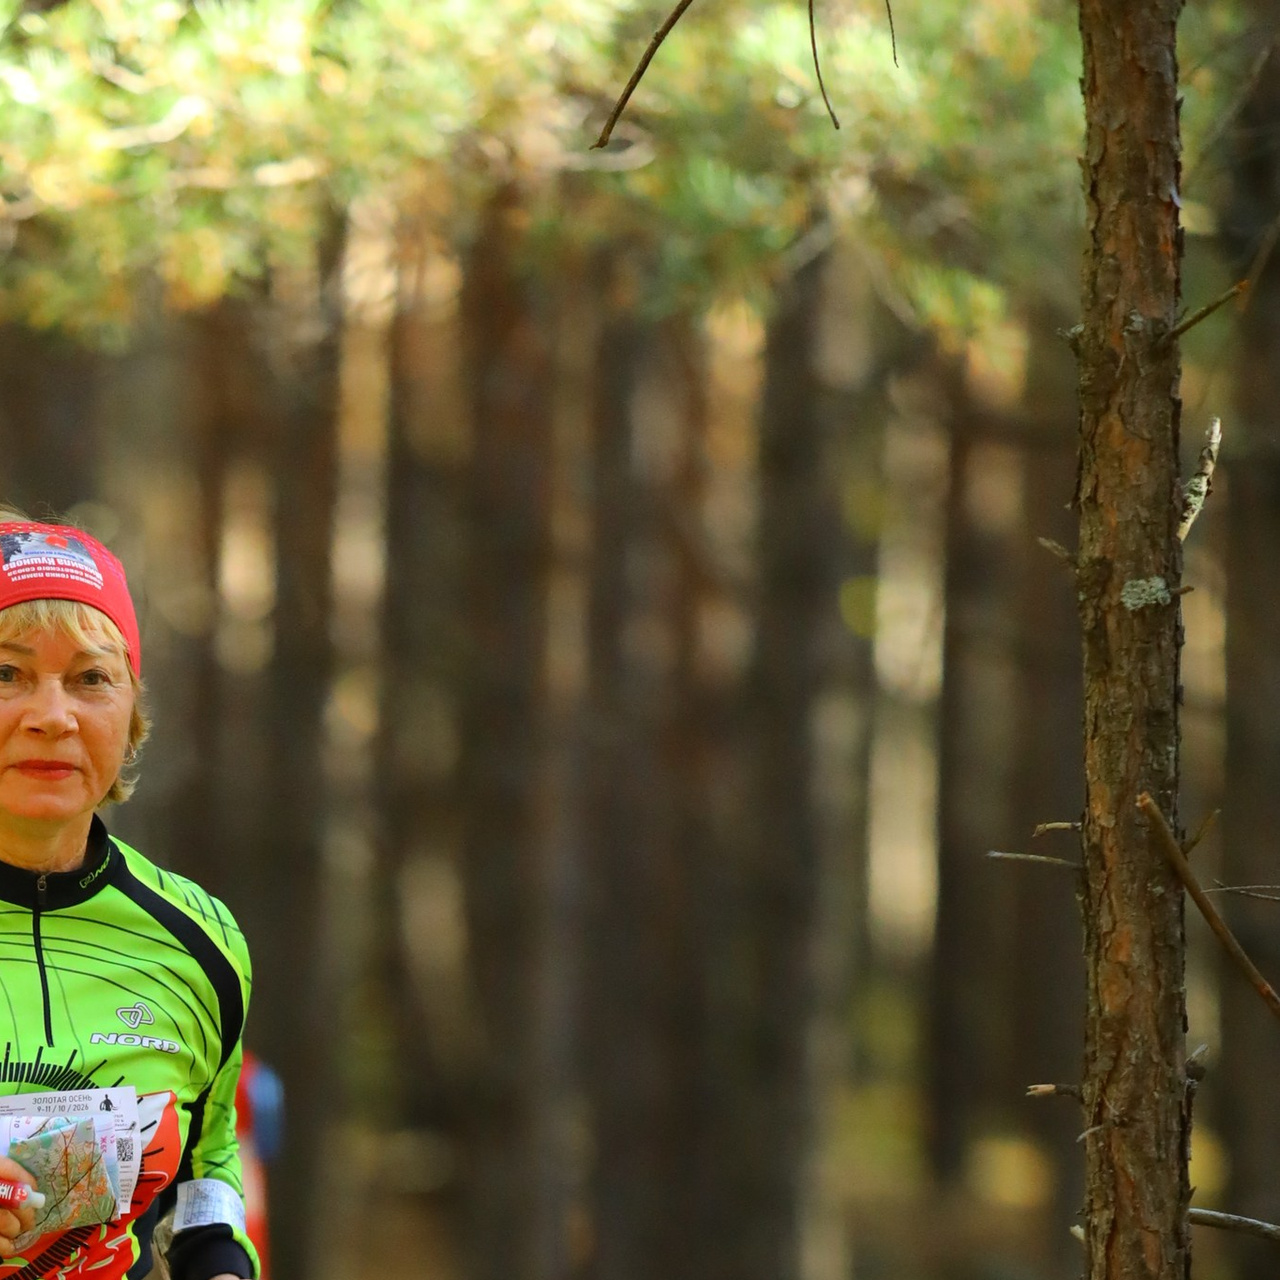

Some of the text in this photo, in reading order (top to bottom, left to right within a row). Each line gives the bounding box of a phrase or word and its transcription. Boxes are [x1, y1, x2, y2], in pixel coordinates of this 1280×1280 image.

[90, 1033, 180, 1054] NORD
[32, 1094, 93, 1105] ЗОЛОТАЯ ОСЕНЬ
